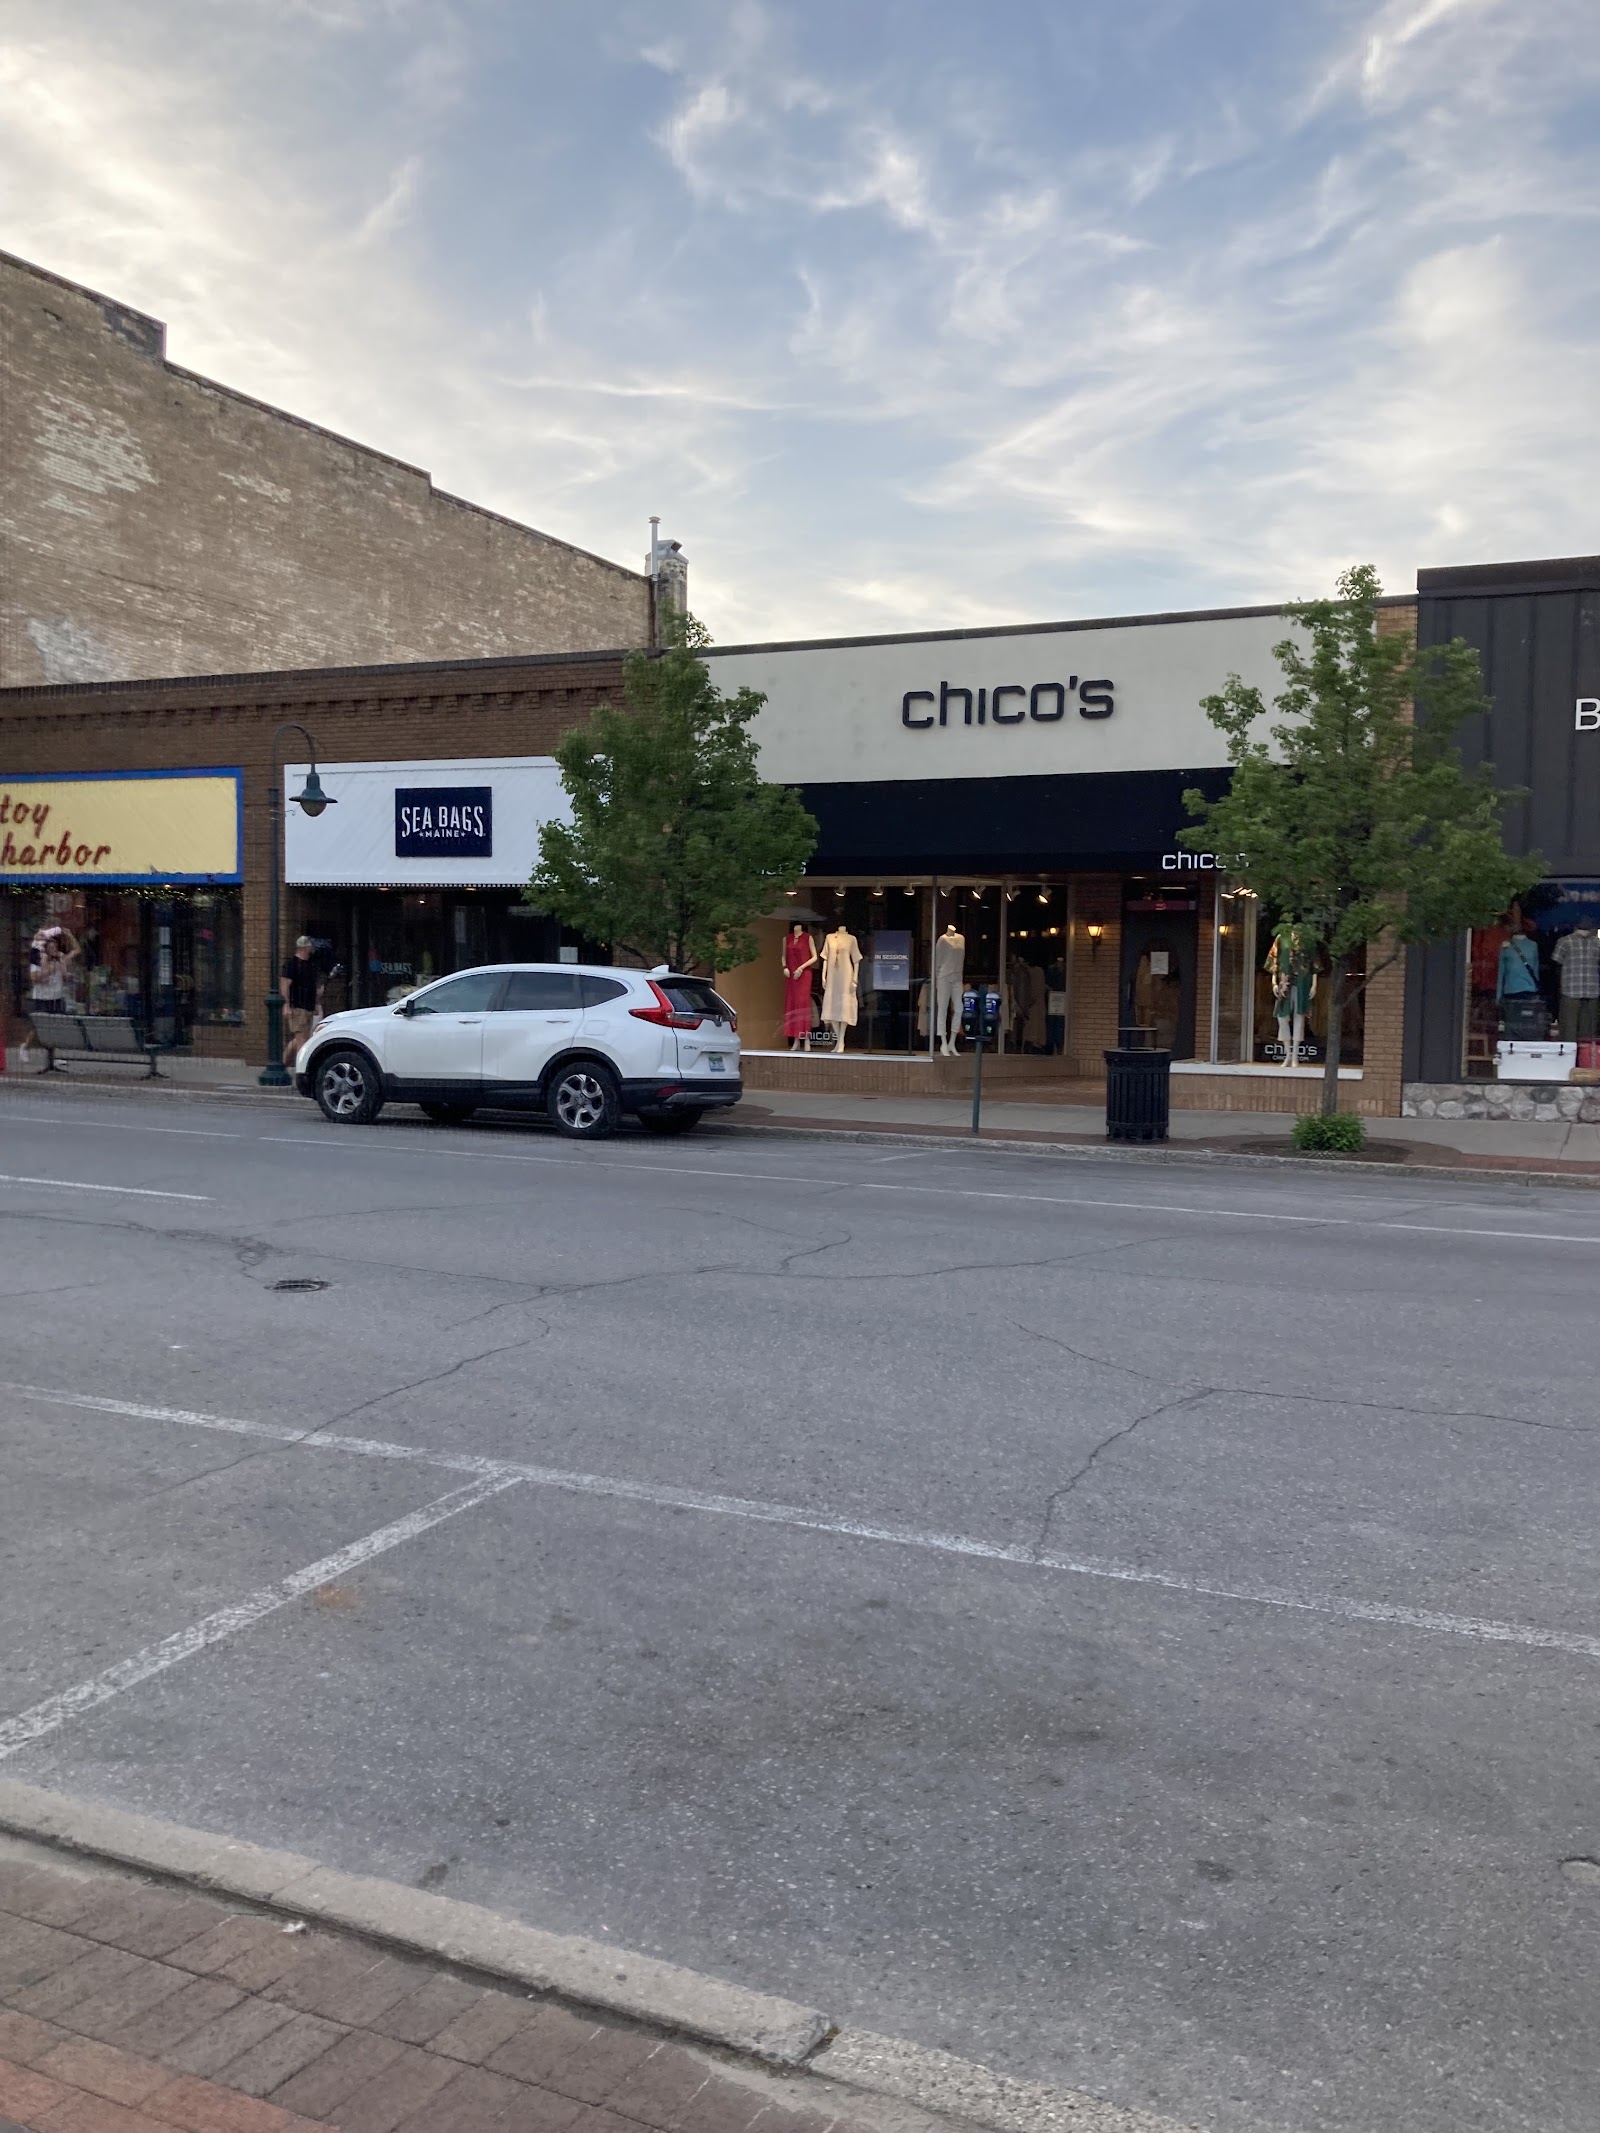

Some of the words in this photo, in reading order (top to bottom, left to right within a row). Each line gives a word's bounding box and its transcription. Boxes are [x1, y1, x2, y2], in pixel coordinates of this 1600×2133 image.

[902, 675, 1114, 729] chico's
[0, 794, 50, 839] toy
[401, 806, 433, 838] SEA
[438, 805, 484, 838] BAGS
[425, 829, 460, 838] MAINE
[0, 830, 112, 866] harbor
[1162, 851, 1250, 870] chics
[798, 1030, 839, 1041] chico's
[1264, 1043, 1318, 1056] cho's
